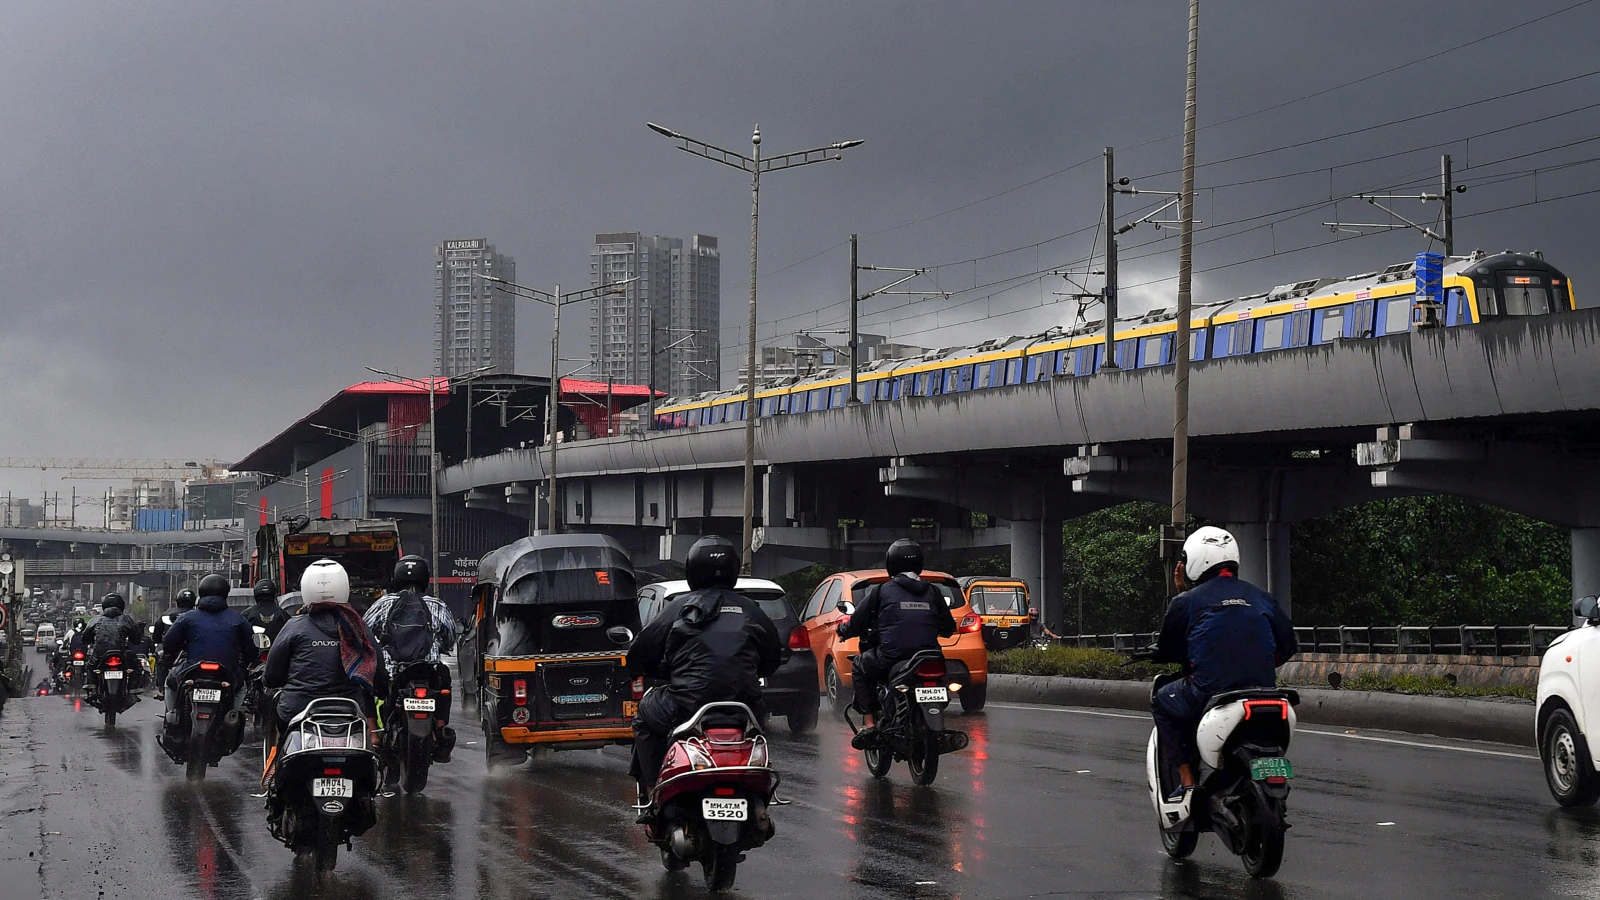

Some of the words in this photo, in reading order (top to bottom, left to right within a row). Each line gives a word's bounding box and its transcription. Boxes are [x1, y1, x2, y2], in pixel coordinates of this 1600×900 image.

[447, 240, 479, 249] KALPATARU
[320, 778, 346, 788] MH04L
[320, 787, 346, 796] A7587
[707, 809, 744, 819] 3520
